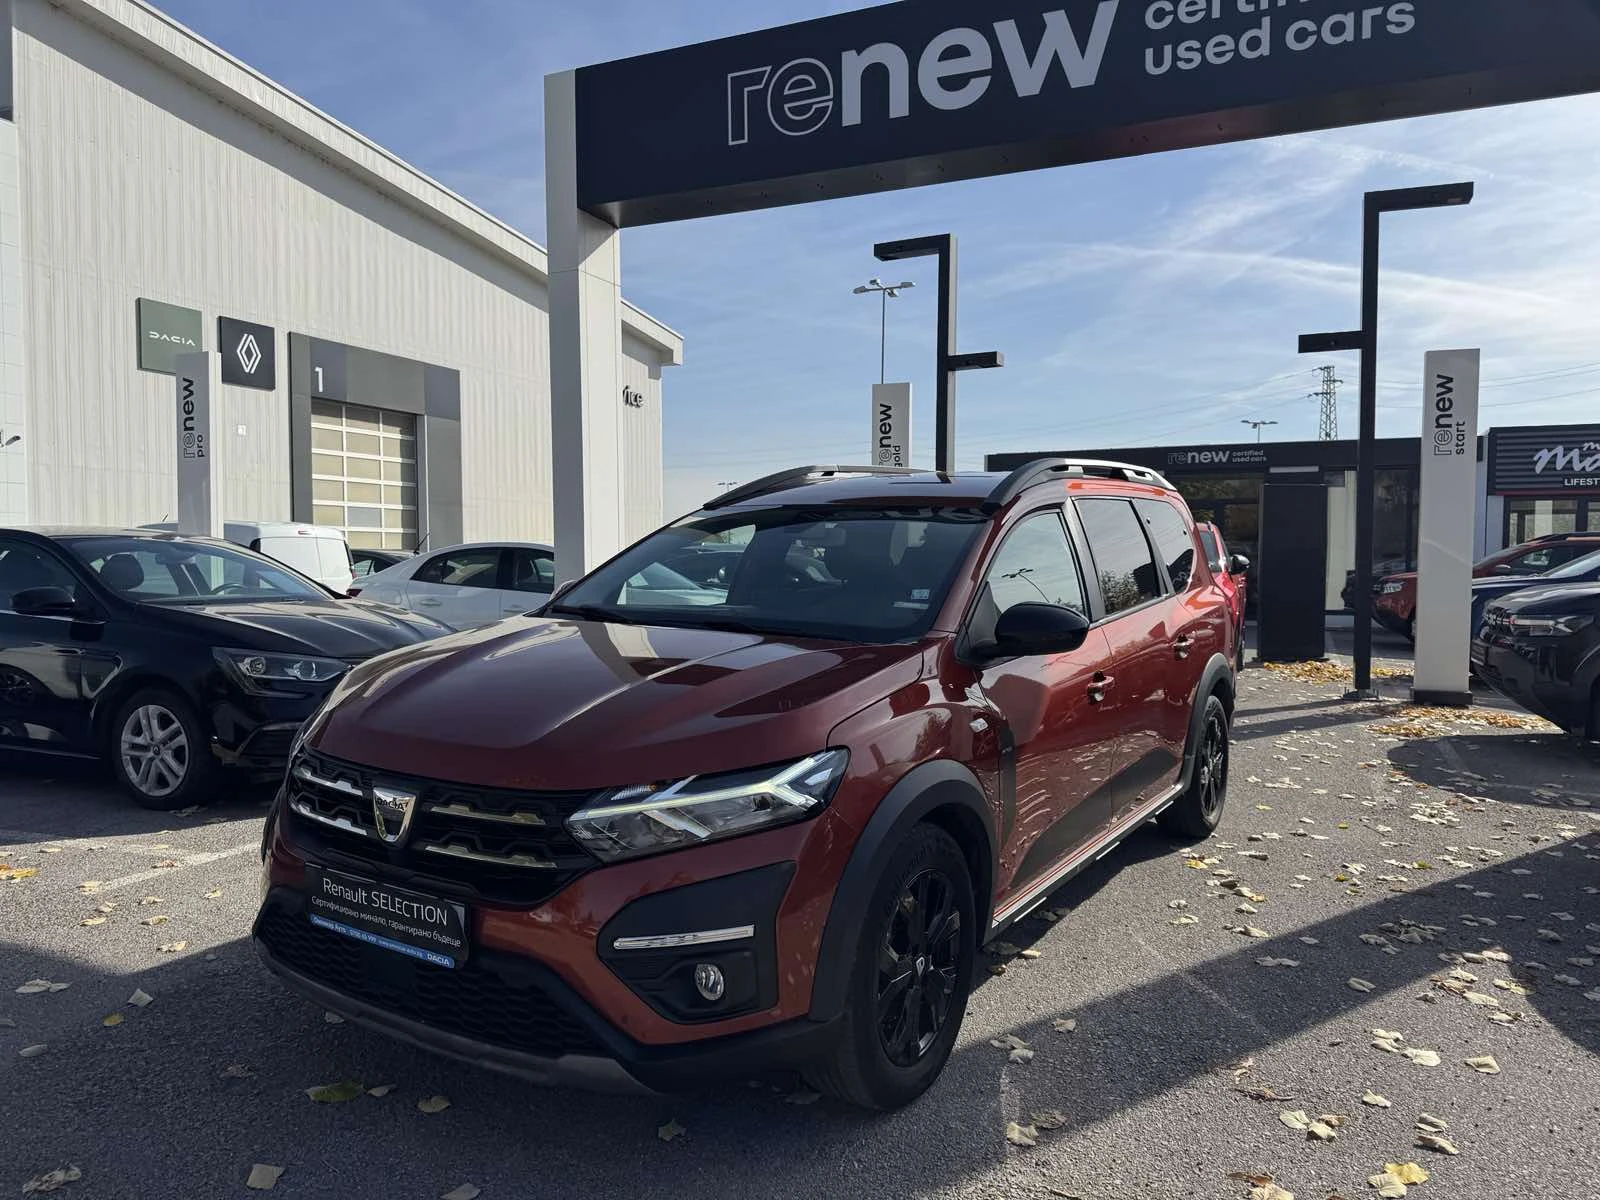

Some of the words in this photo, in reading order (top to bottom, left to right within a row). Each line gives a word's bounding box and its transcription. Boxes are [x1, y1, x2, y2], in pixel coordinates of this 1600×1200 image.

[1144, 16, 1270, 75] used
[1285, 2, 1415, 51] cars
[727, 0, 1121, 146] renew
[149, 330, 196, 346] DACIA
[314, 366, 323, 393] 1
[182, 377, 196, 459] renew
[879, 403, 893, 466] enew
[1433, 373, 1454, 456] renew
[1455, 420, 1466, 455] start
[1167, 450, 1230, 464] renew
[322, 877, 368, 905] Renault
[371, 891, 448, 926] SELECTION
[427, 953, 451, 967] DACIA
